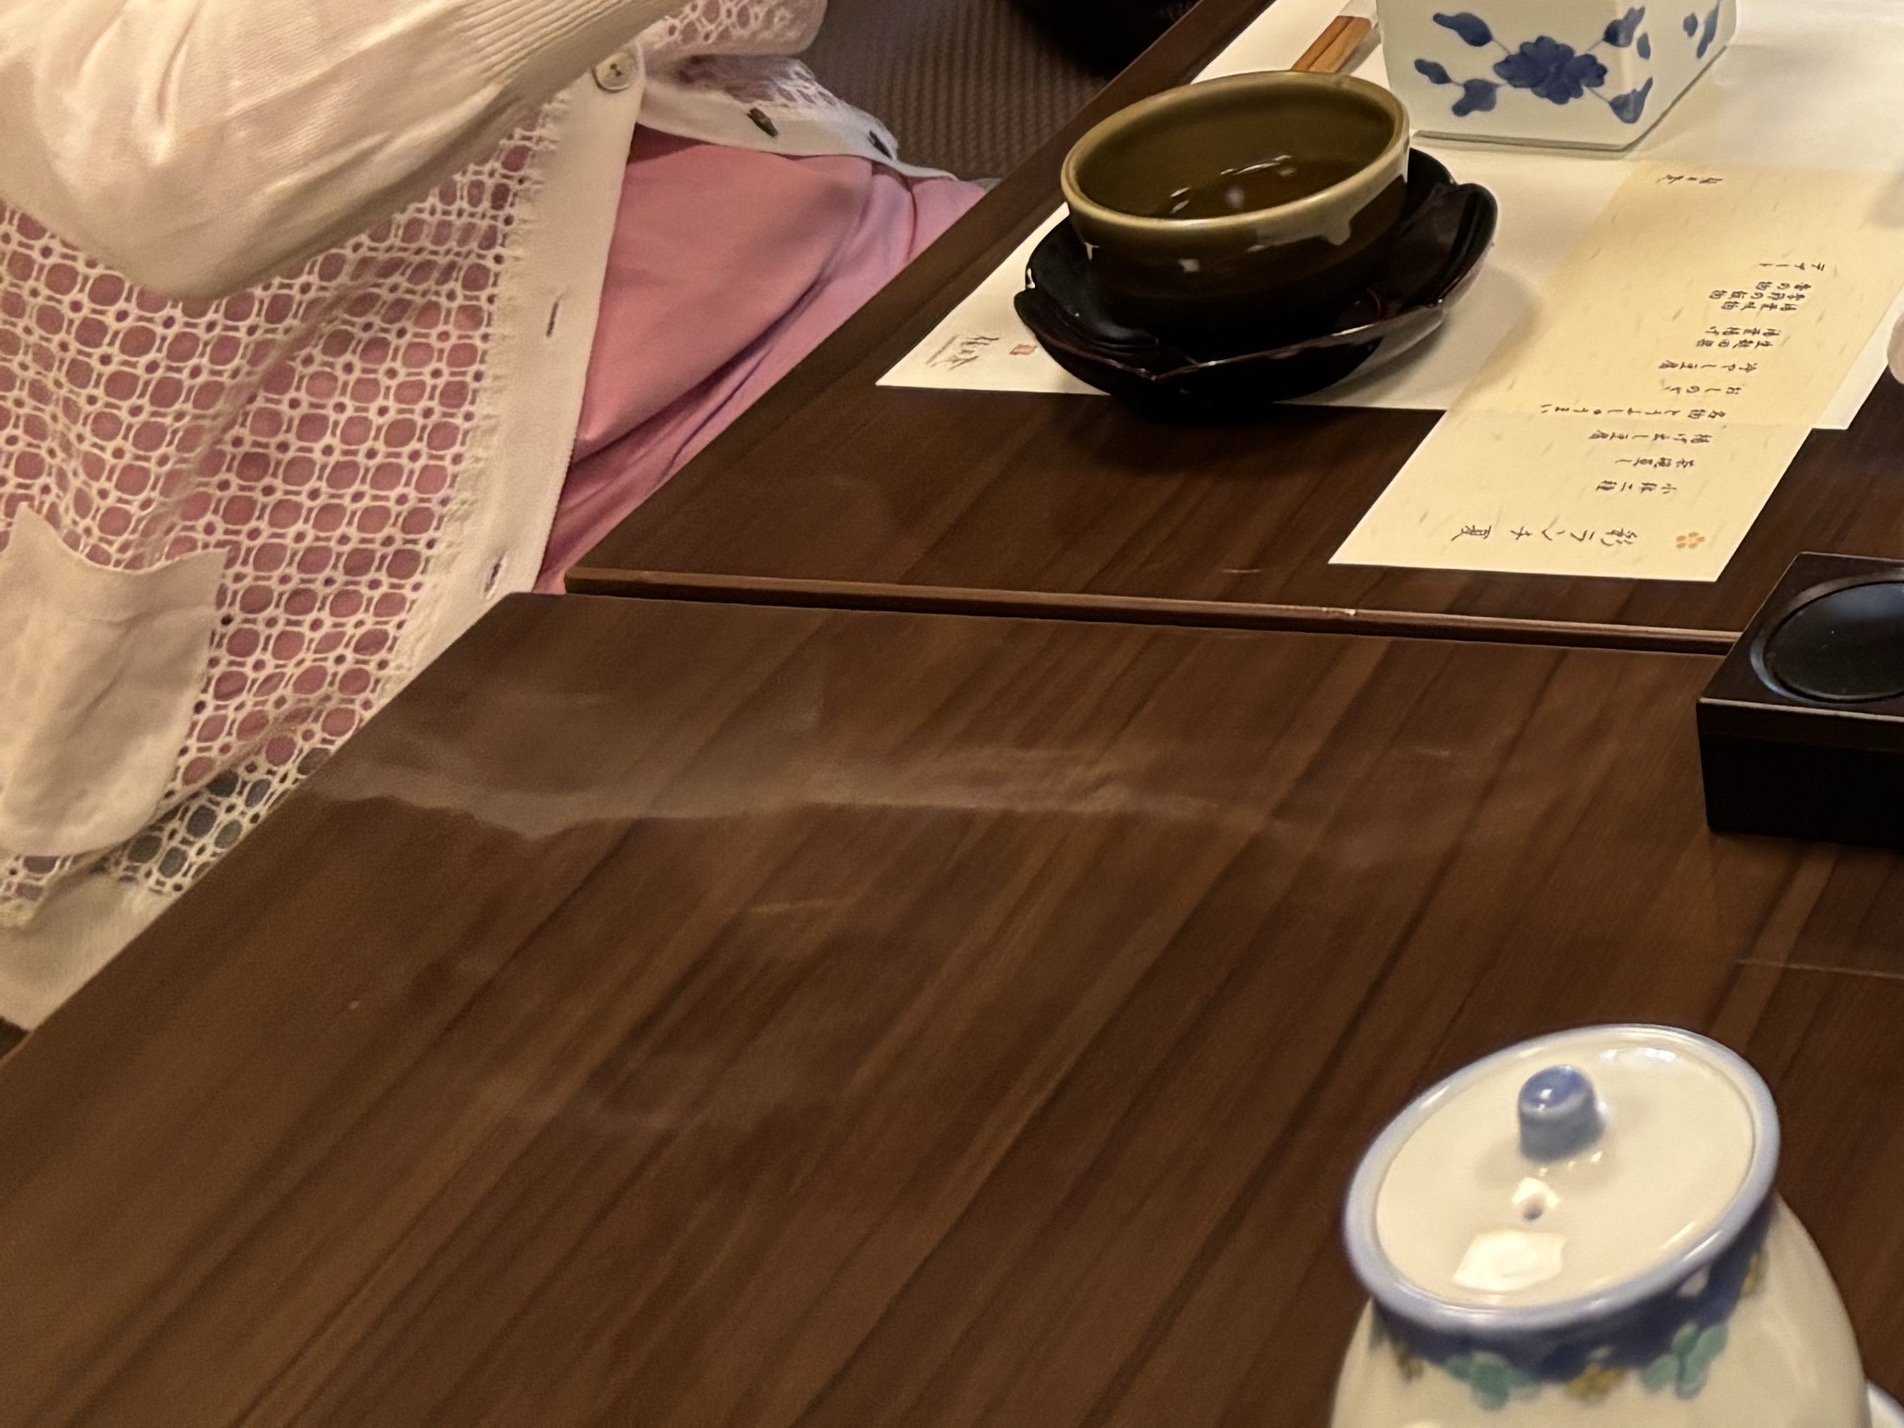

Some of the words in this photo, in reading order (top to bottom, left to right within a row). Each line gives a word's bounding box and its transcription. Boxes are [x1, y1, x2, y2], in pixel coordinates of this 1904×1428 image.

[1450, 524, 1492, 542] 夏
[1509, 522, 1638, 547] 彩ランチ
